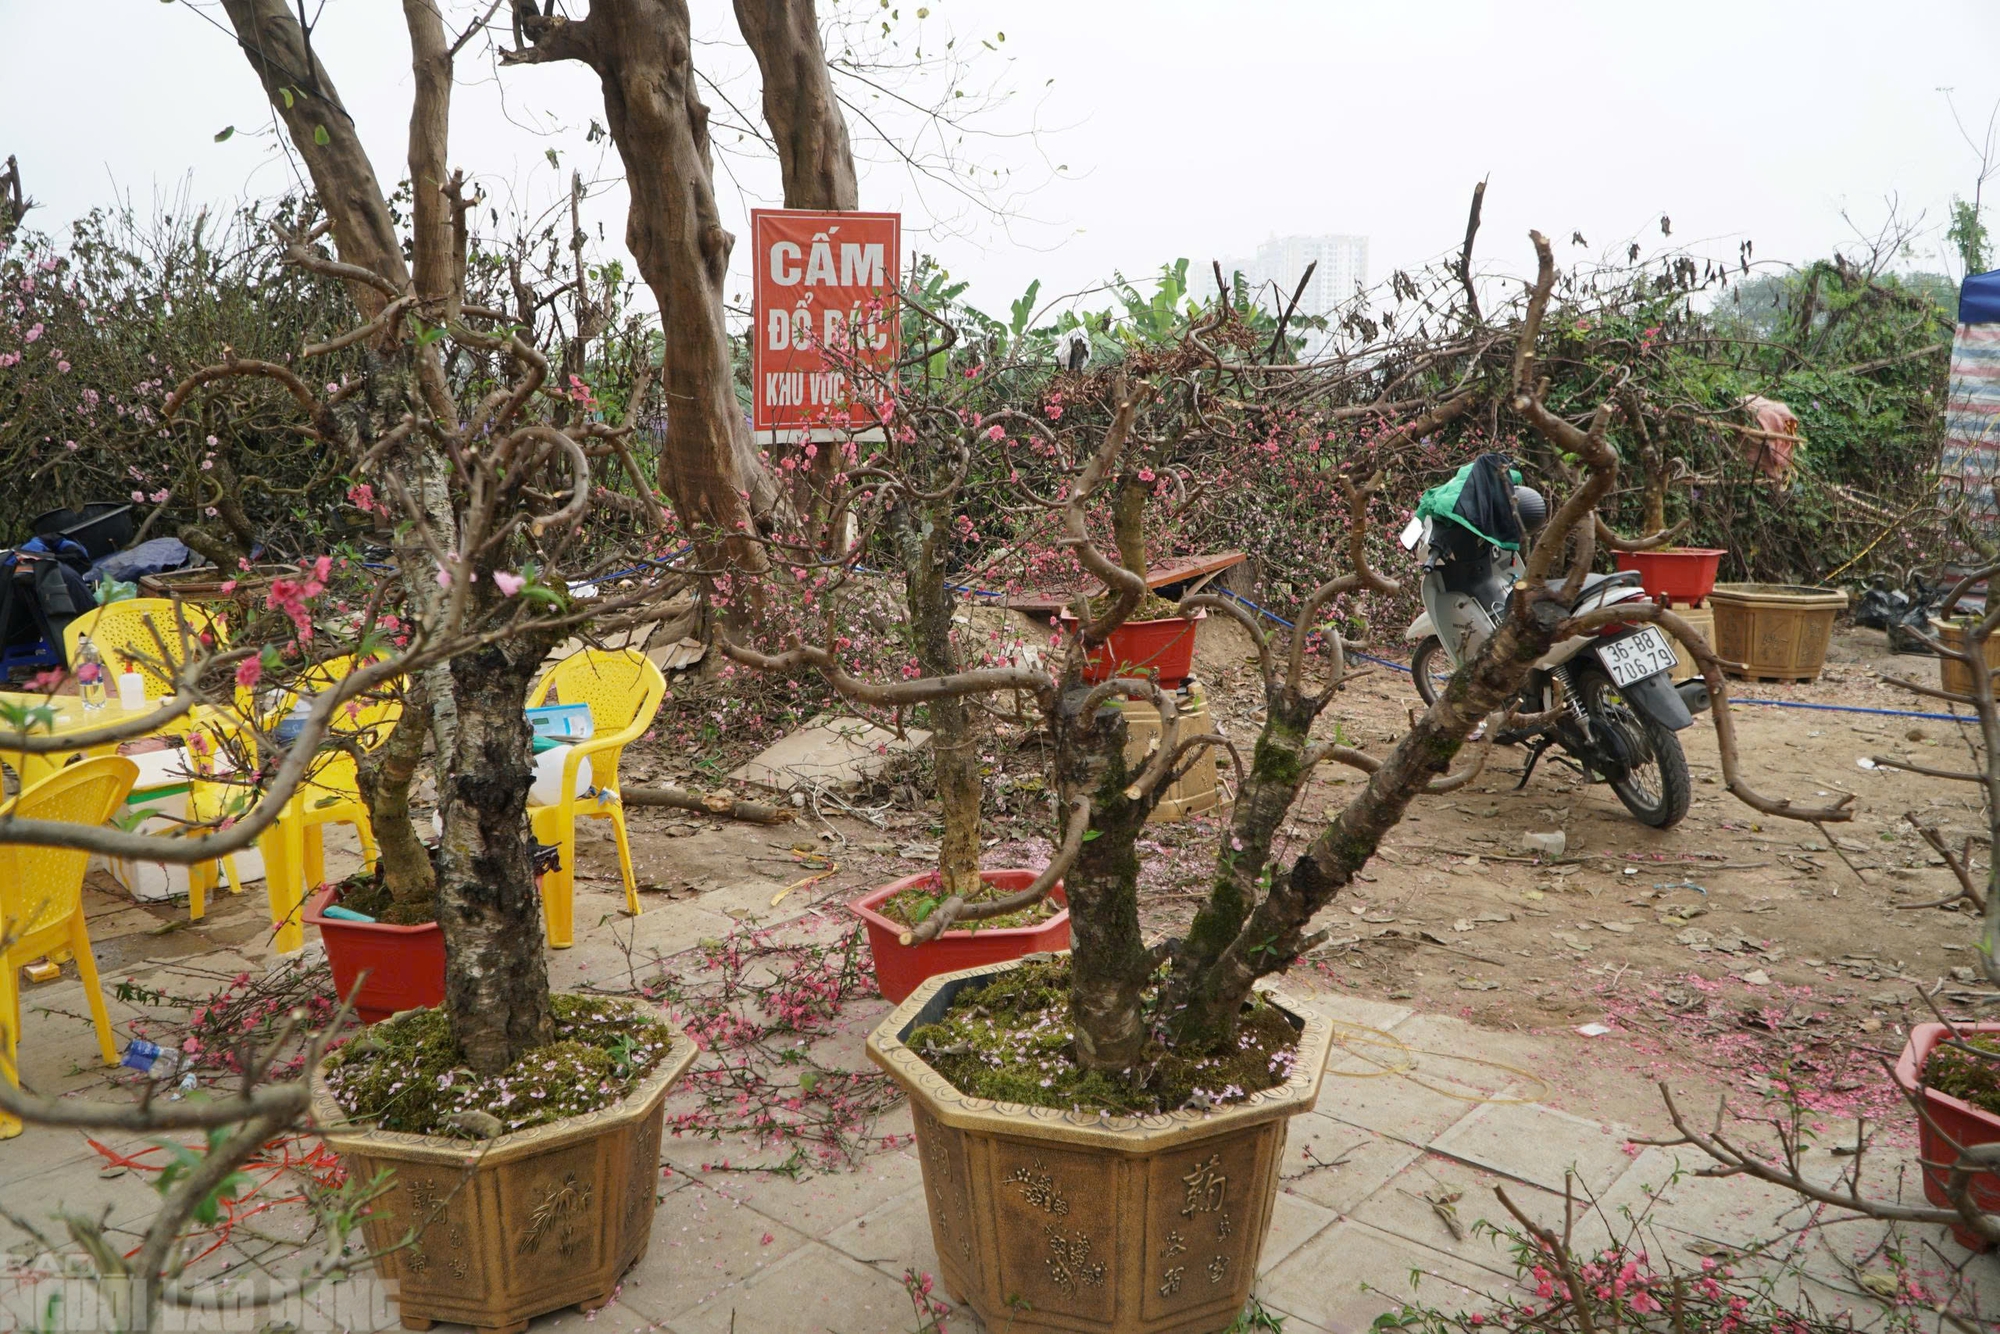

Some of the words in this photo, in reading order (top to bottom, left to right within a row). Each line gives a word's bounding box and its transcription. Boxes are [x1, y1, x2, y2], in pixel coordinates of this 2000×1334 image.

[770, 226, 885, 287] CẤM
[768, 292, 814, 351] ĐỔ
[766, 372, 804, 406] KHU
[809, 371, 845, 413] VỰC
[1607, 632, 1655, 663] 36-B8
[1612, 648, 1673, 684] 706.79
